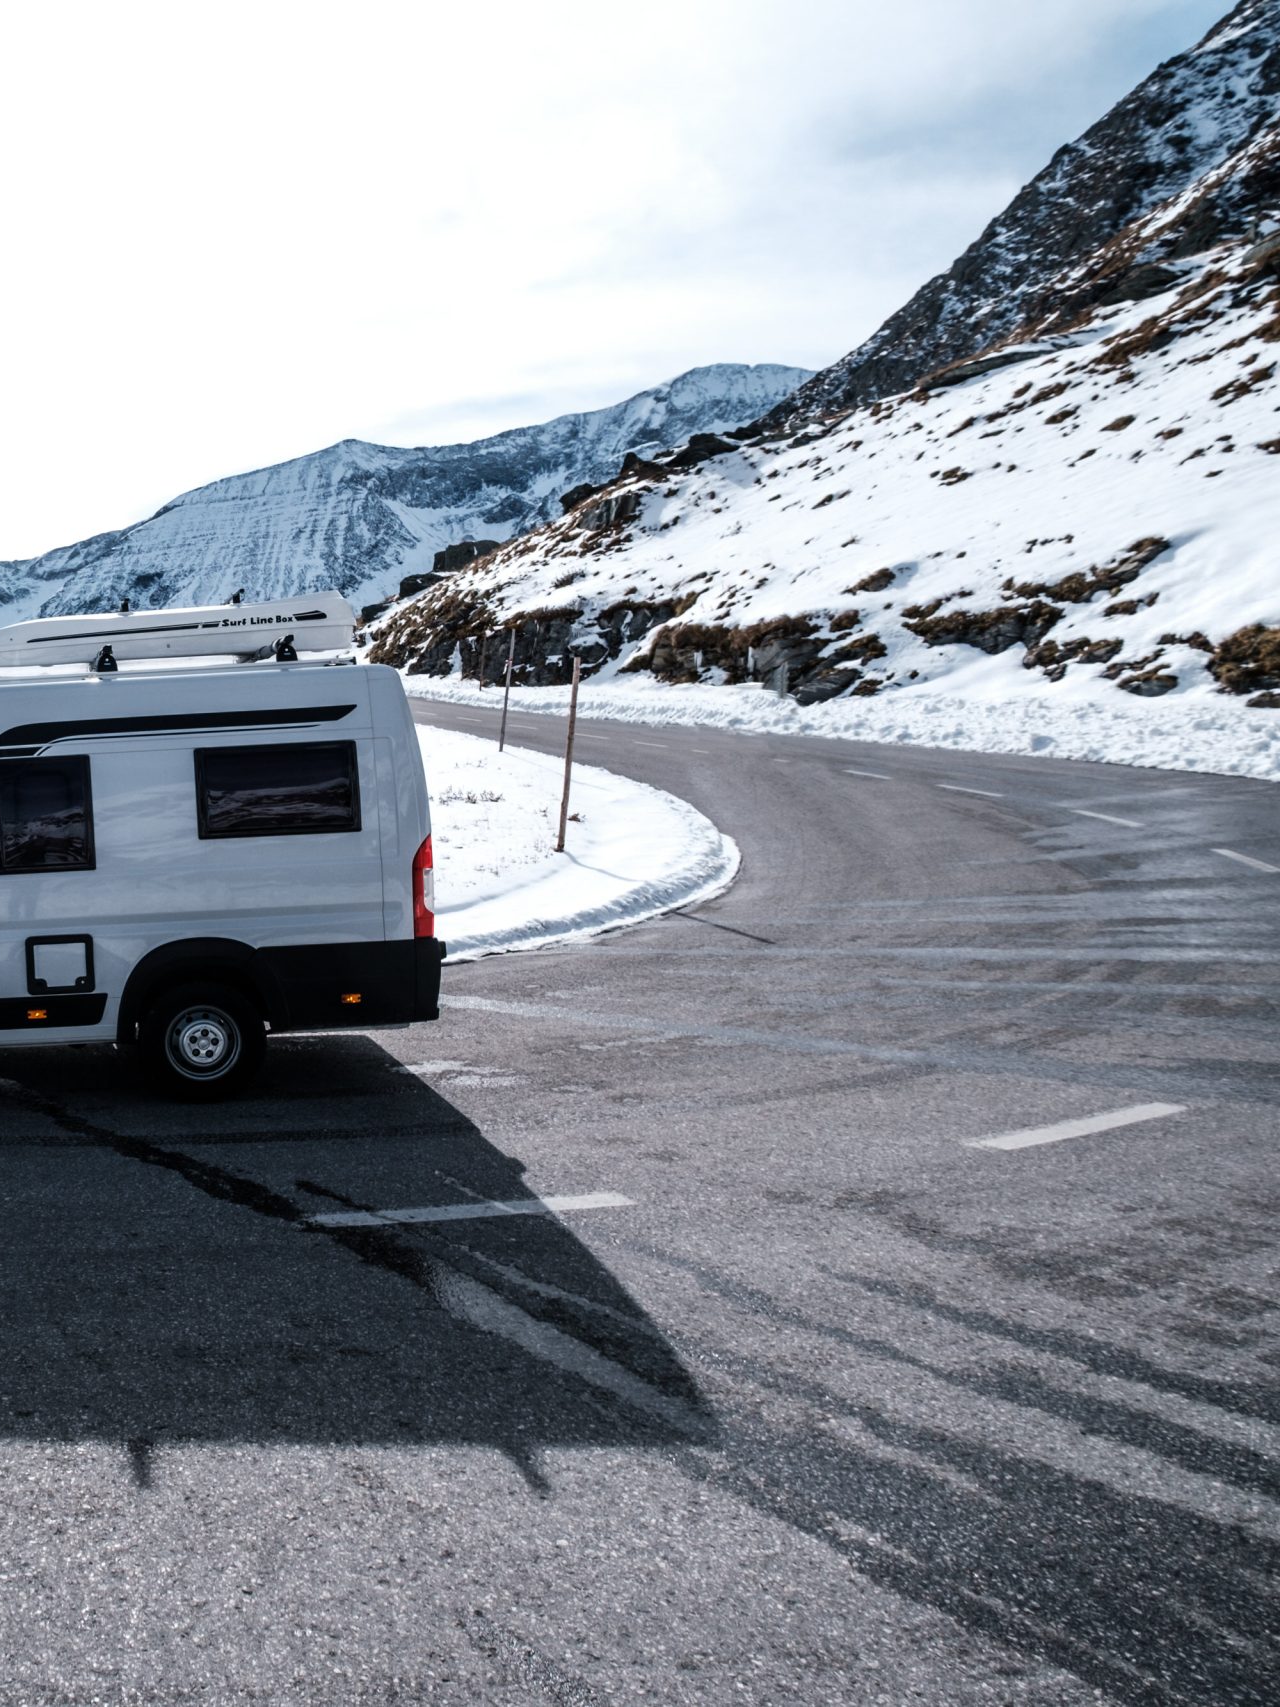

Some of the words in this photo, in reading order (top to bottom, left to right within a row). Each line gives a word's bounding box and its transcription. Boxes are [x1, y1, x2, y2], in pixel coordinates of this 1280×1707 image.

[221, 618, 247, 628] Surf
[250, 616, 273, 625] Line
[275, 614, 294, 623] Box
